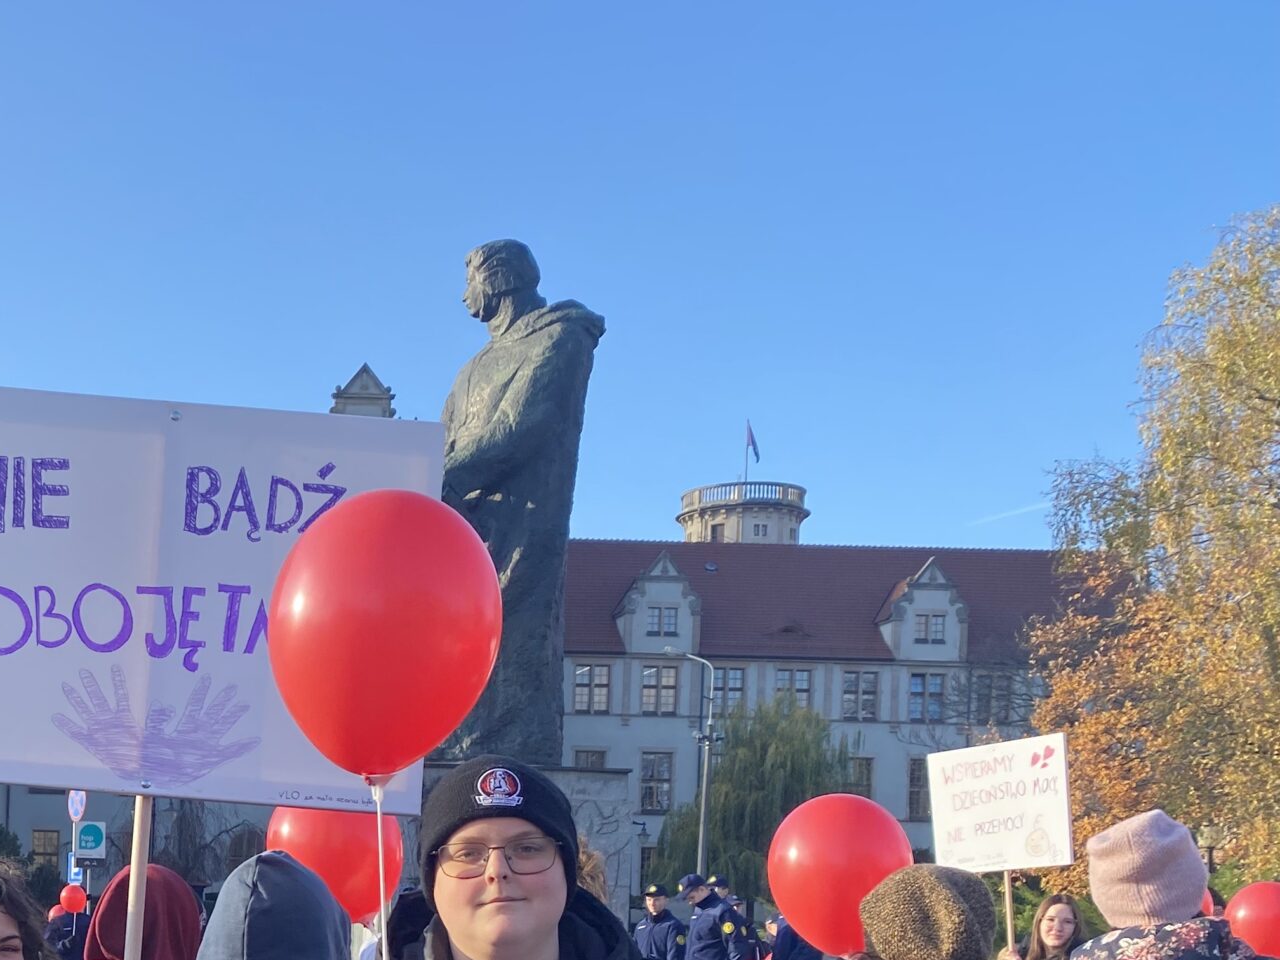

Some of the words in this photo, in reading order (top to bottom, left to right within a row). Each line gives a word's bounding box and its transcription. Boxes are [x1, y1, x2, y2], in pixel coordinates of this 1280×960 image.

[183, 462, 347, 542] BĄDŹ
[947, 828, 965, 845] NIE
[975, 813, 1025, 837] PRZEMOCY
